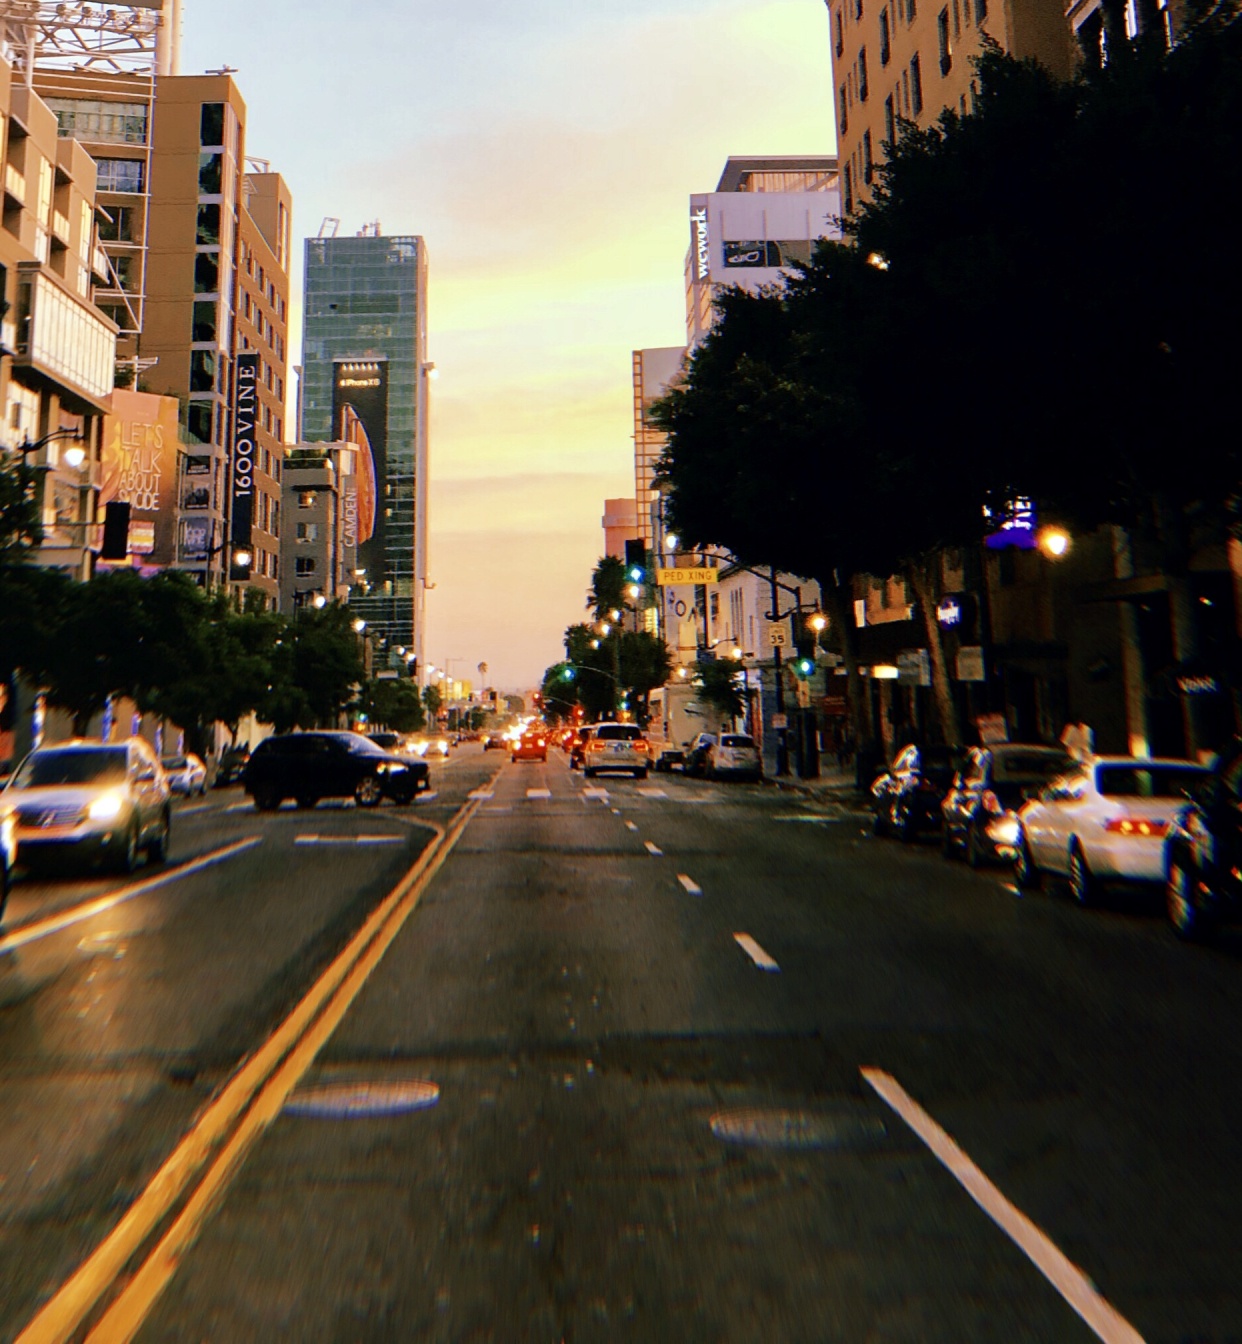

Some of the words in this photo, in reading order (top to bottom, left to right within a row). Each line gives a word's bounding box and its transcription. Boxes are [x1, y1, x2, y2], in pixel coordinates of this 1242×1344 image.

[690, 207, 709, 280] wework
[237, 365, 256, 434] VINE
[122, 420, 164, 449] LET'S
[120, 446, 162, 474] TALK
[235, 438, 253, 498] 1600
[118, 471, 162, 493] ABOUT
[344, 492, 357, 548] CAMDEN
[663, 571, 684, 581] PED
[688, 570, 712, 581] XING
[771, 634, 785, 644] 35
